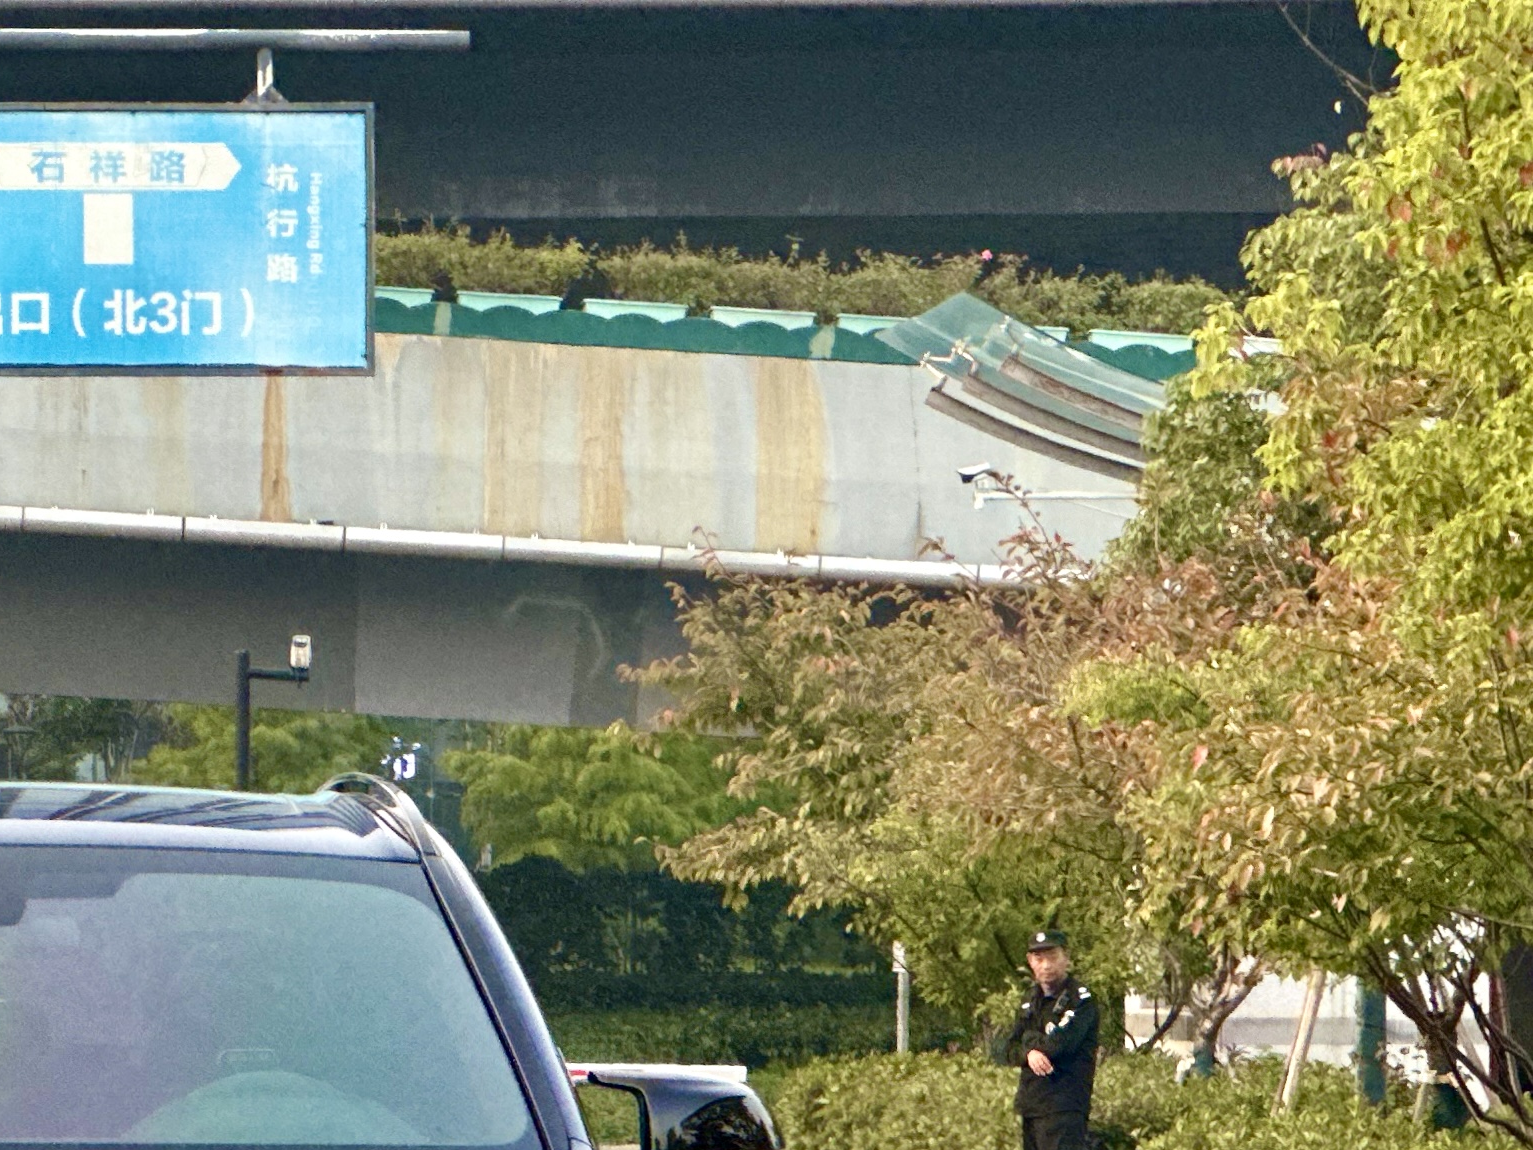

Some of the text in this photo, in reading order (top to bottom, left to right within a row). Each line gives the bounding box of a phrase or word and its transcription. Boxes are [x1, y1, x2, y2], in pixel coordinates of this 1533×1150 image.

[28, 150, 187, 184] 石祥路
[266, 162, 299, 284] 杭行路
[306, 172, 324, 275] Hangxing Rd
